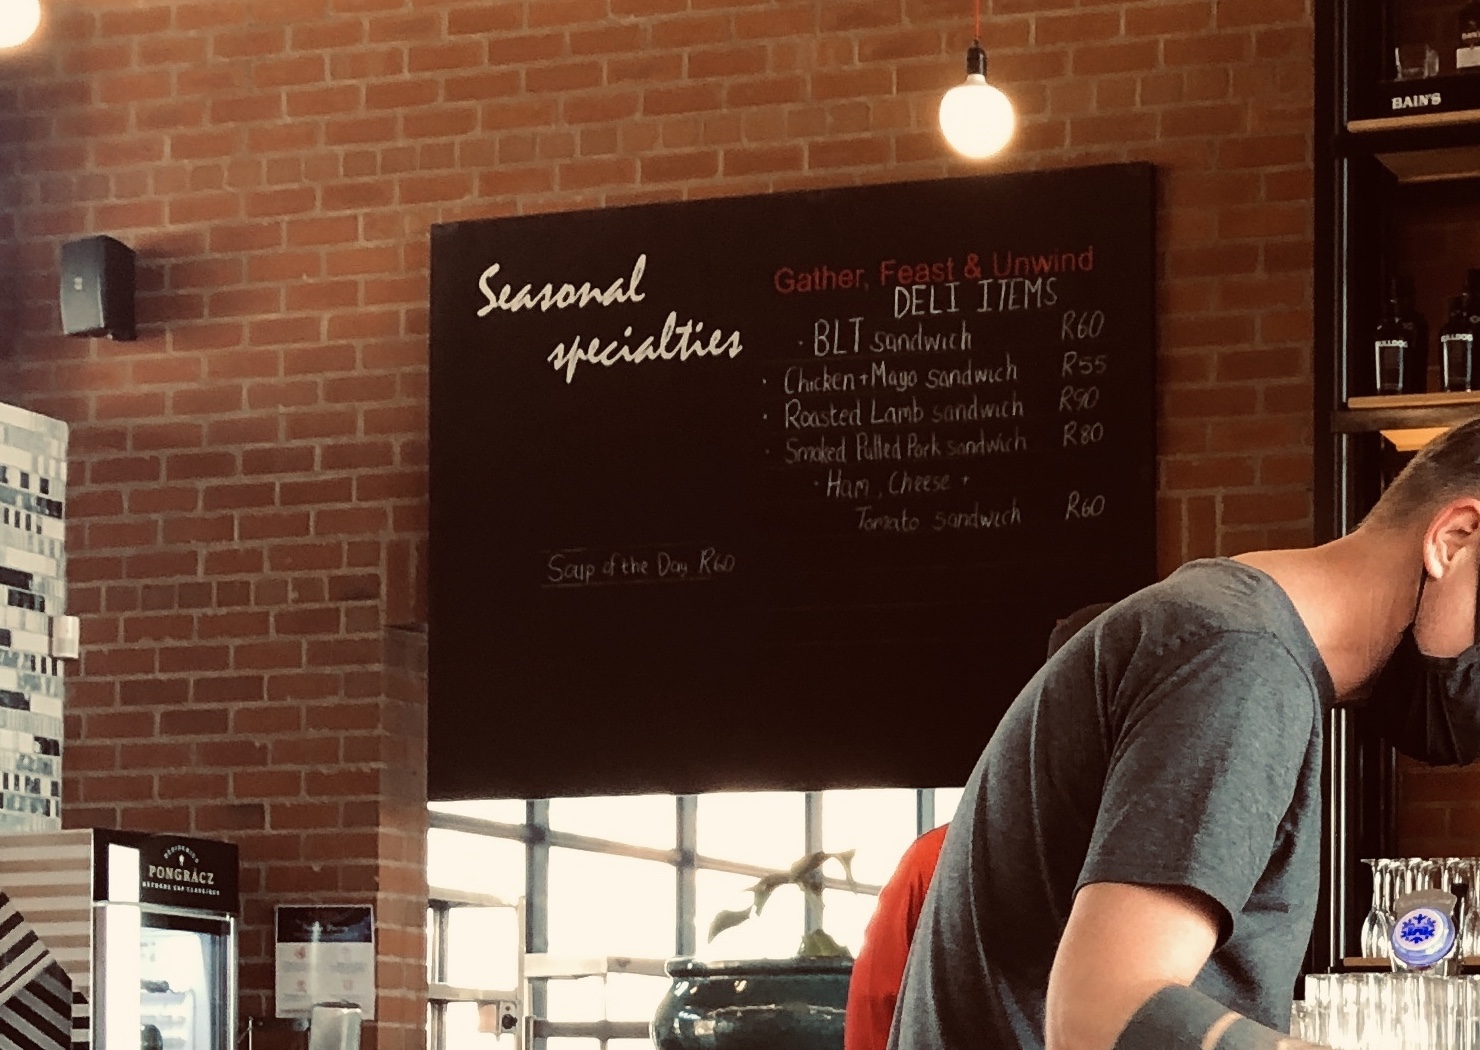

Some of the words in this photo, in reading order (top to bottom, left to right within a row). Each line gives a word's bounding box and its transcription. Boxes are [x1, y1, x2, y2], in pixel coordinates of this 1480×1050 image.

[1391, 92, 1442, 110] BAIN'S
[476, 253, 647, 318] Seasonal
[773, 265, 870, 294] Gather,
[880, 257, 955, 286] Feast
[963, 252, 982, 279] &
[992, 246, 1095, 278] Unwind
[894, 282, 960, 320] DELI
[976, 277, 1058, 313] ITEMS
[546, 310, 744, 385] specialties
[813, 316, 865, 358] BLT
[868, 319, 973, 353] sandwich
[1060, 308, 1106, 342] R60
[925, 352, 1018, 389] sandwich
[1061, 351, 1108, 378] R55
[784, 398, 862, 429] Roasted
[870, 396, 924, 425] Lamb
[930, 390, 1025, 424] sandwich
[1058, 385, 1101, 413] R90
[784, 435, 847, 465] Smoked
[855, 431, 902, 462] Pulled
[907, 431, 942, 459] Pork
[946, 426, 1028, 457] sandwich
[1062, 420, 1105, 448] R80
[888, 471, 952, 496] Cheese
[855, 504, 921, 533] Tomato
[932, 498, 1023, 532] sandwich
[1064, 489, 1106, 522] R60
[621, 556, 649, 575] the
[657, 551, 688, 578] Day
[699, 547, 737, 574] R60
